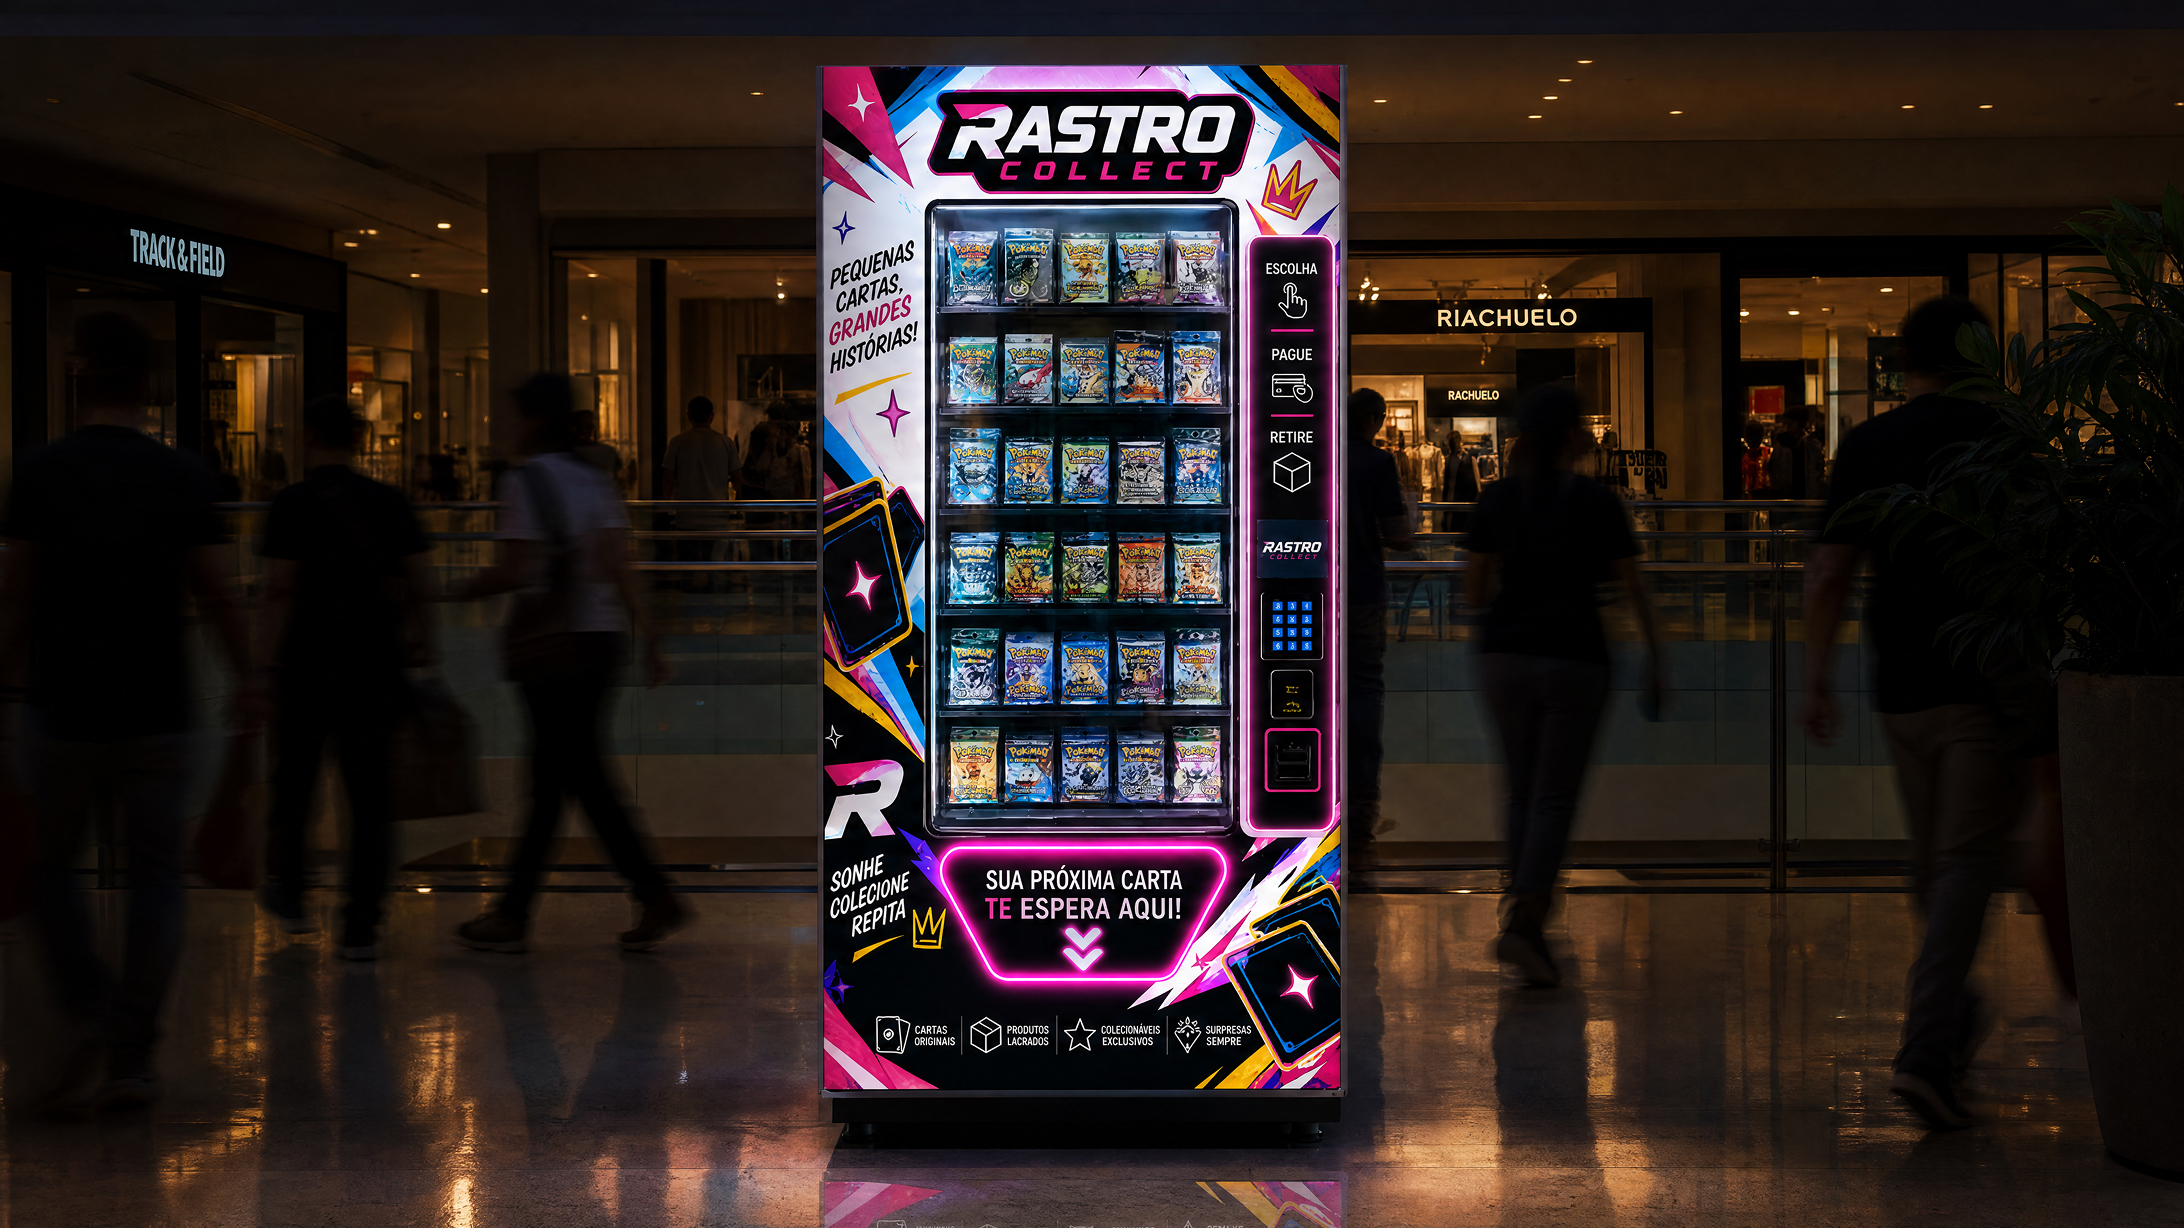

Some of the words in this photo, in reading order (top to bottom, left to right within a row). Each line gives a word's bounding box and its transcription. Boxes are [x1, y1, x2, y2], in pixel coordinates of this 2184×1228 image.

[948, 104, 1236, 159] RASTRO
[1000, 161, 1218, 180] COLLECT
[830, 240, 914, 290] PEQUENAS
[1266, 262, 1317, 275] ESCOLHA
[836, 273, 903, 313] CARTAS,
[829, 294, 911, 345] GRANDES
[1437, 308, 1577, 327] RIACHUELO
[830, 321, 918, 374] HISTÓRIAS!
[1272, 348, 1313, 361] PAGUE
[1448, 390, 1499, 401] RACHUELO
[1270, 430, 1313, 443] RETIRE
[1262, 541, 1322, 553] RASTRO
[830, 854, 884, 892] SONHE
[986, 869, 1024, 890] SUA
[1030, 865, 1115, 890] PRÓXIMA
[1121, 869, 1183, 890] CARTA
[830, 871, 910, 919] COLECIONE
[985, 897, 1012, 919] TE
[1021, 897, 1110, 919] ESPERA
[1118, 897, 1181, 920] AQUI!
[851, 898, 906, 938] REPITA
[914, 1025, 948, 1035] CARTAS
[1007, 1025, 1049, 1035] PRODUTOS
[1101, 1023, 1161, 1035] COLECIONÁVEIS
[1205, 1025, 1252, 1035] SURPRESAS
[914, 1036, 956, 1046] ORIGINAIS
[1007, 1036, 1049, 1046] LACRADOS
[1102, 1036, 1154, 1046] EXCLUSIVOS
[1206, 1036, 1242, 1046] SEMPRE
